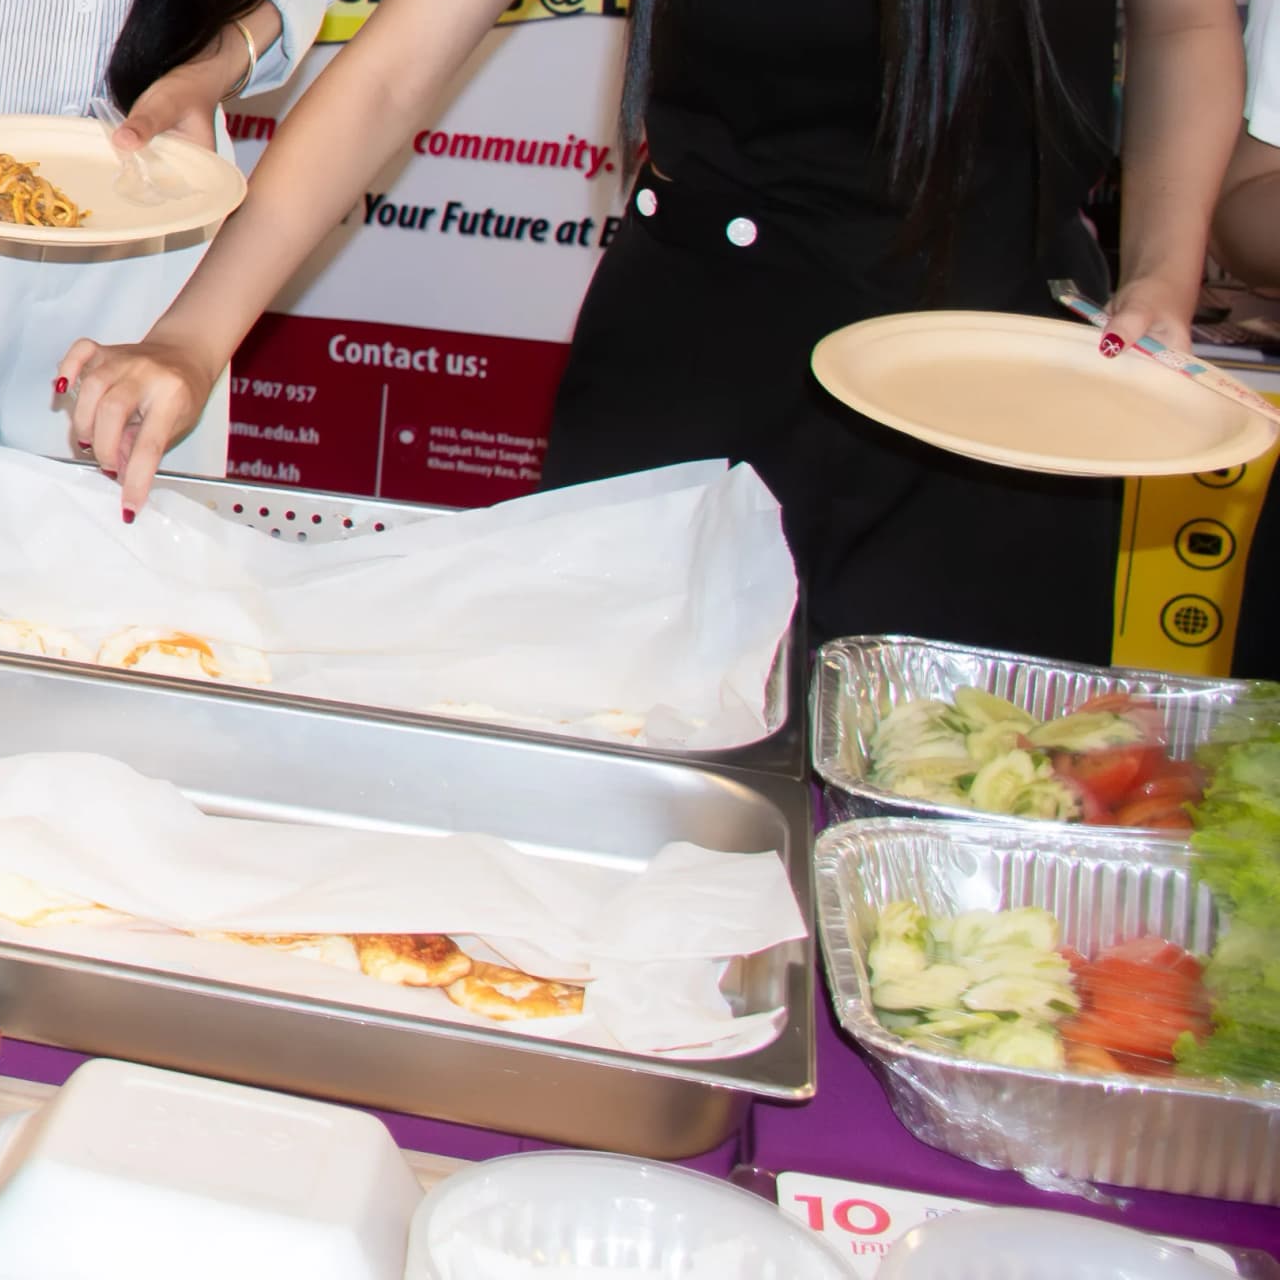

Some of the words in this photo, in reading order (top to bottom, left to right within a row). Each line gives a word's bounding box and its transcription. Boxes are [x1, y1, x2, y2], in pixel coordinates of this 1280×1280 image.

[413, 128, 615, 179] community.
[362, 192, 435, 232] Your
[440, 200, 551, 244] Future
[556, 218, 594, 247] at
[327, 333, 440, 373] Contact
[445, 351, 489, 380] us:
[252, 380, 282, 399] 907
[286, 383, 317, 403] 957
[229, 421, 320, 446] mu.edu.kh
